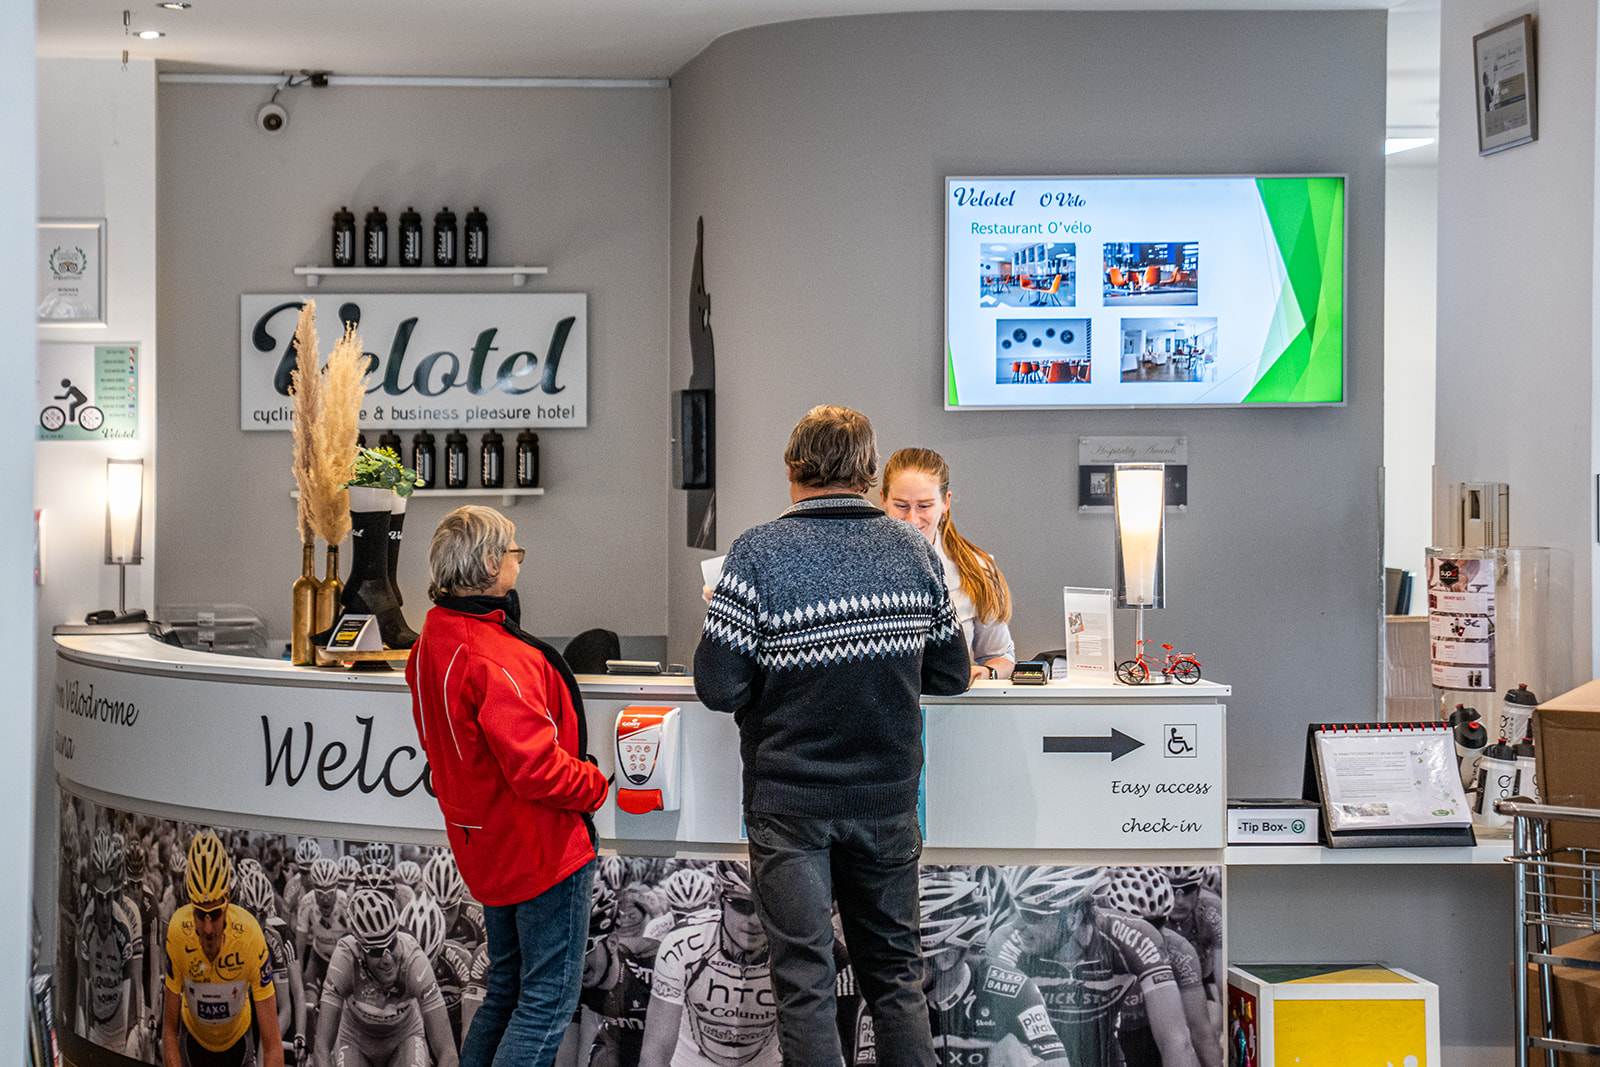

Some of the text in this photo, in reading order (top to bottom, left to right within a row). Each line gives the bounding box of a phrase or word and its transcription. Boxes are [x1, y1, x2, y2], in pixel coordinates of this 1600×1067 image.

[953, 187, 1016, 207] Velotel
[1040, 192, 1086, 207] O Vélo
[971, 220, 1092, 234] Restaurant O'vélo
[374, 406, 383, 420] &
[391, 406, 459, 420] business
[466, 406, 531, 422] pleasure
[537, 405, 574, 419] hotel
[64, 679, 140, 727] Vélodrome
[1111, 780, 1212, 797] Easy access
[1121, 817, 1202, 833] check-in
[219, 952, 244, 968] LCL
[991, 970, 1022, 981] SAXO
[987, 980, 1018, 993] BANK
[200, 1004, 227, 1014] SAXO
